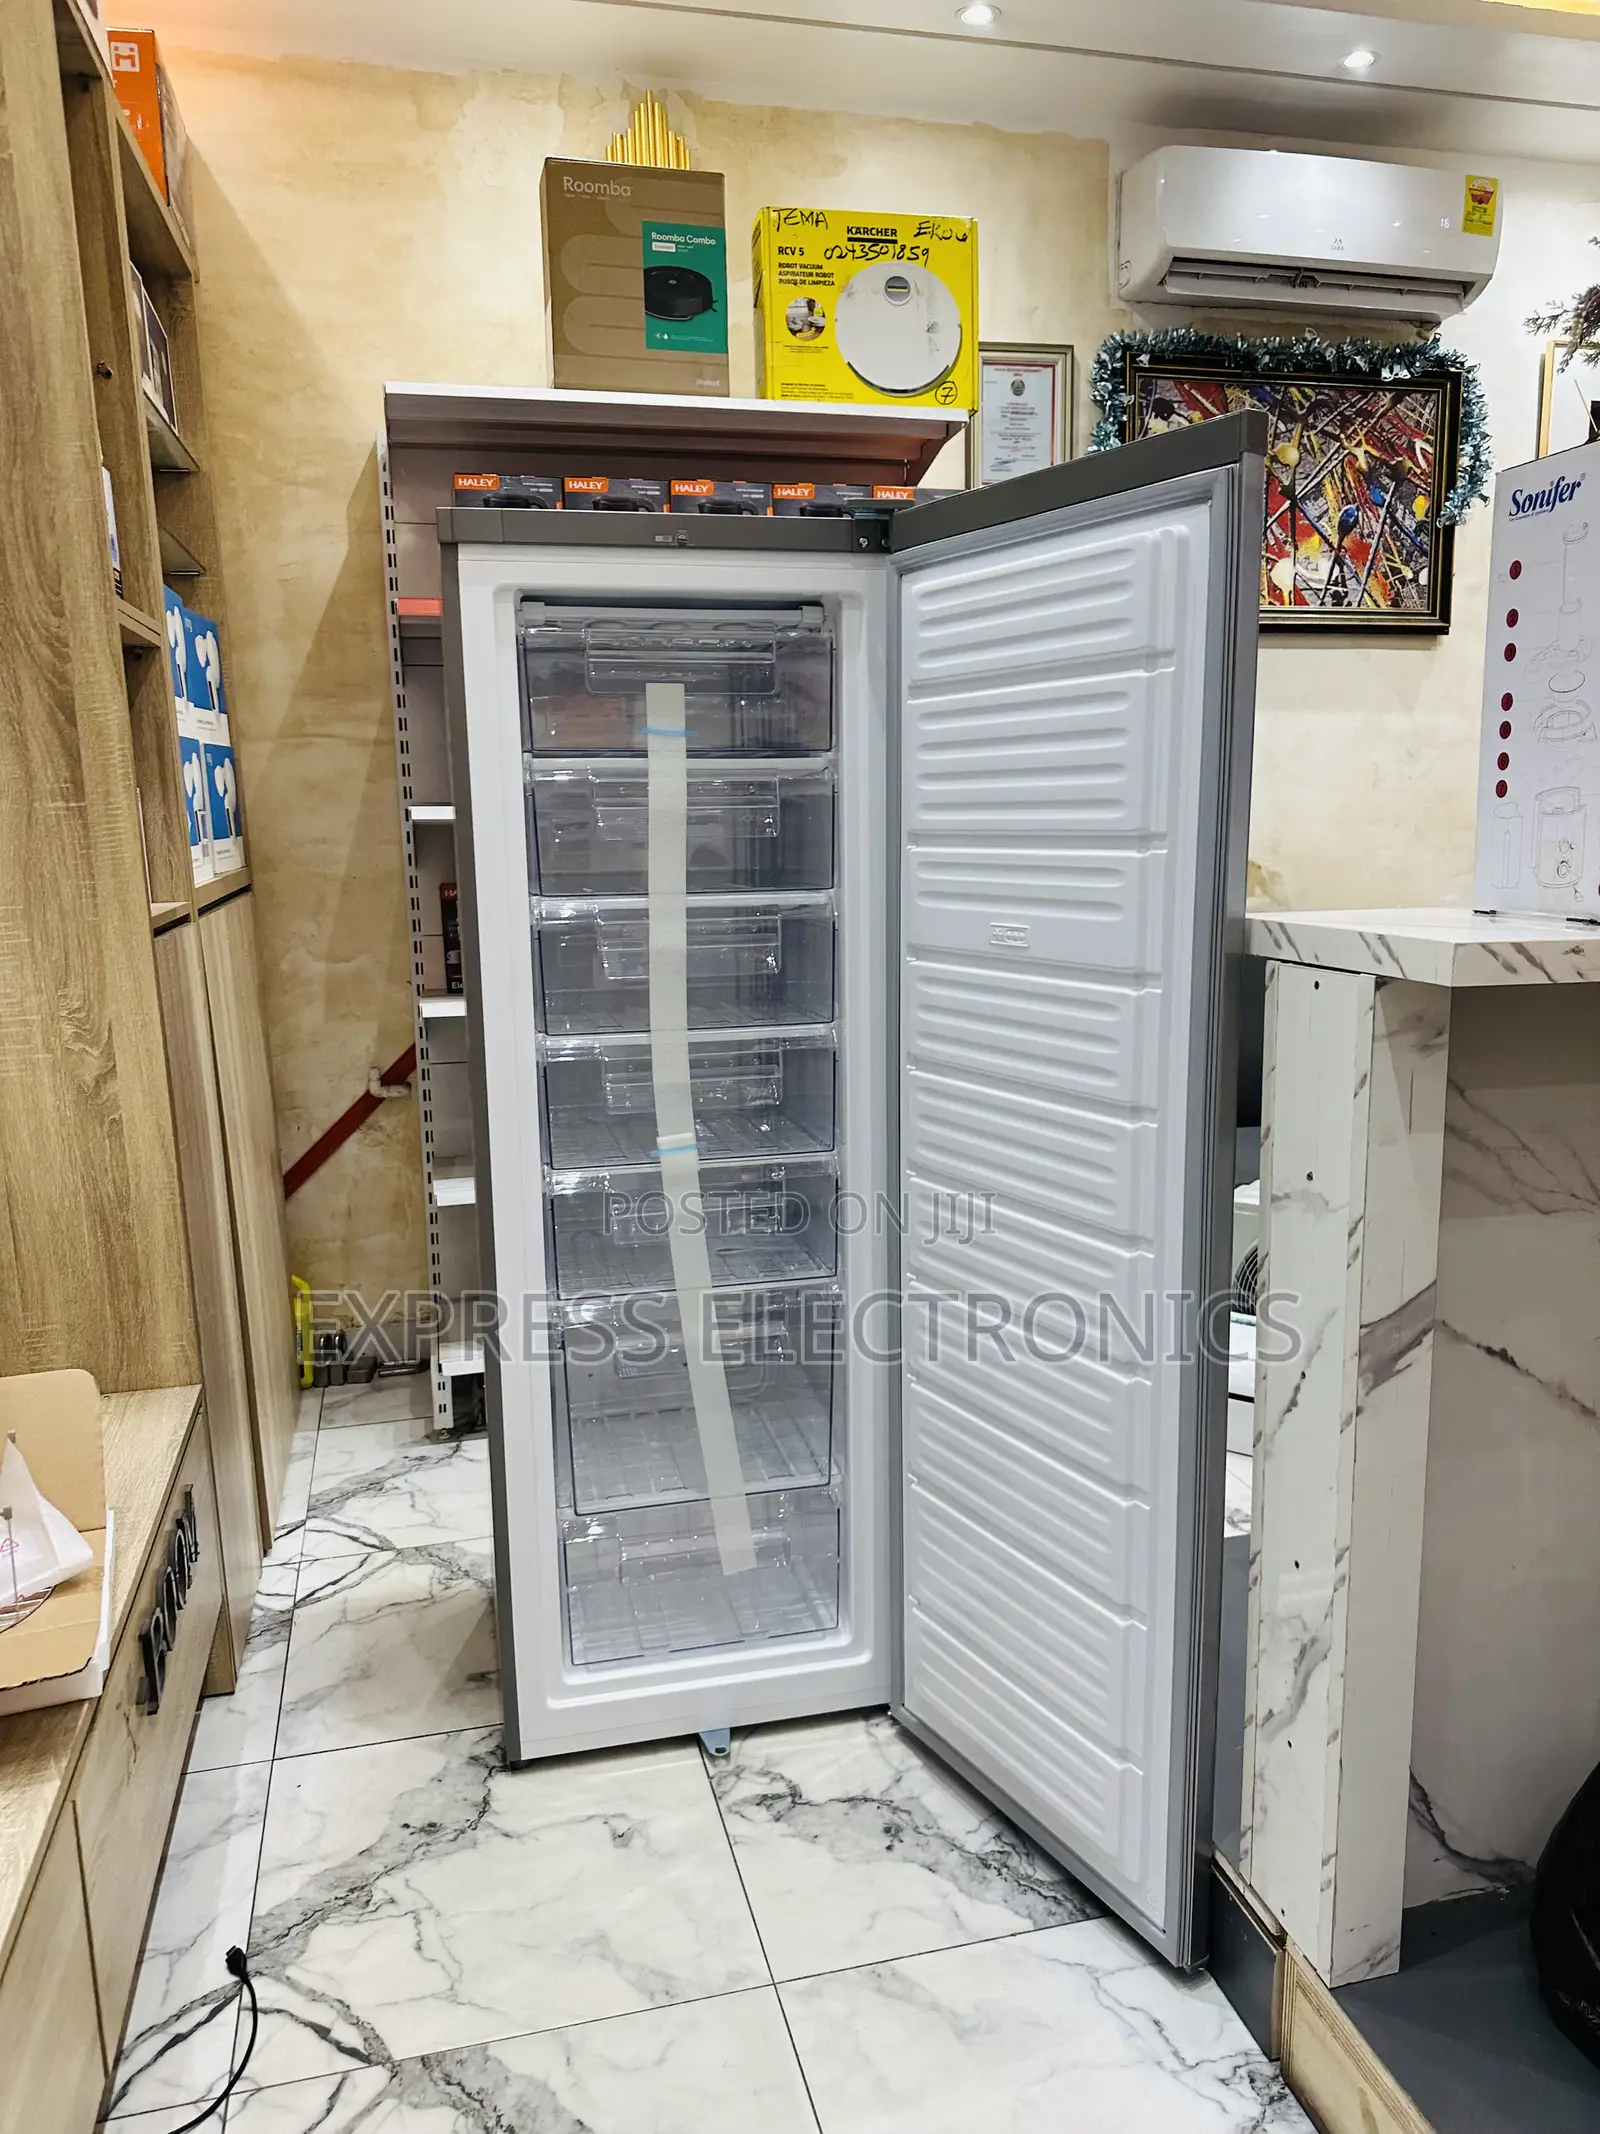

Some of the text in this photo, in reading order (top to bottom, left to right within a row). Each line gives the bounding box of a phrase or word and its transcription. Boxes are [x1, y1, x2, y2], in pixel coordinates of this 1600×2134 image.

[563, 176, 632, 197] Roomba
[772, 208, 829, 232] TEMA
[651, 231, 716, 246] Roomba Combo
[778, 246, 805, 256] RCV 5
[778, 270, 814, 278] ASPIRATEUR
[458, 477, 494, 487] HALEY
[569, 480, 603, 490] HALEY
[675, 483, 709, 493] HALEY
[777, 487, 812, 497] HALEY
[877, 490, 909, 500] HALEY
[1508, 475, 1582, 517] Sonifer
